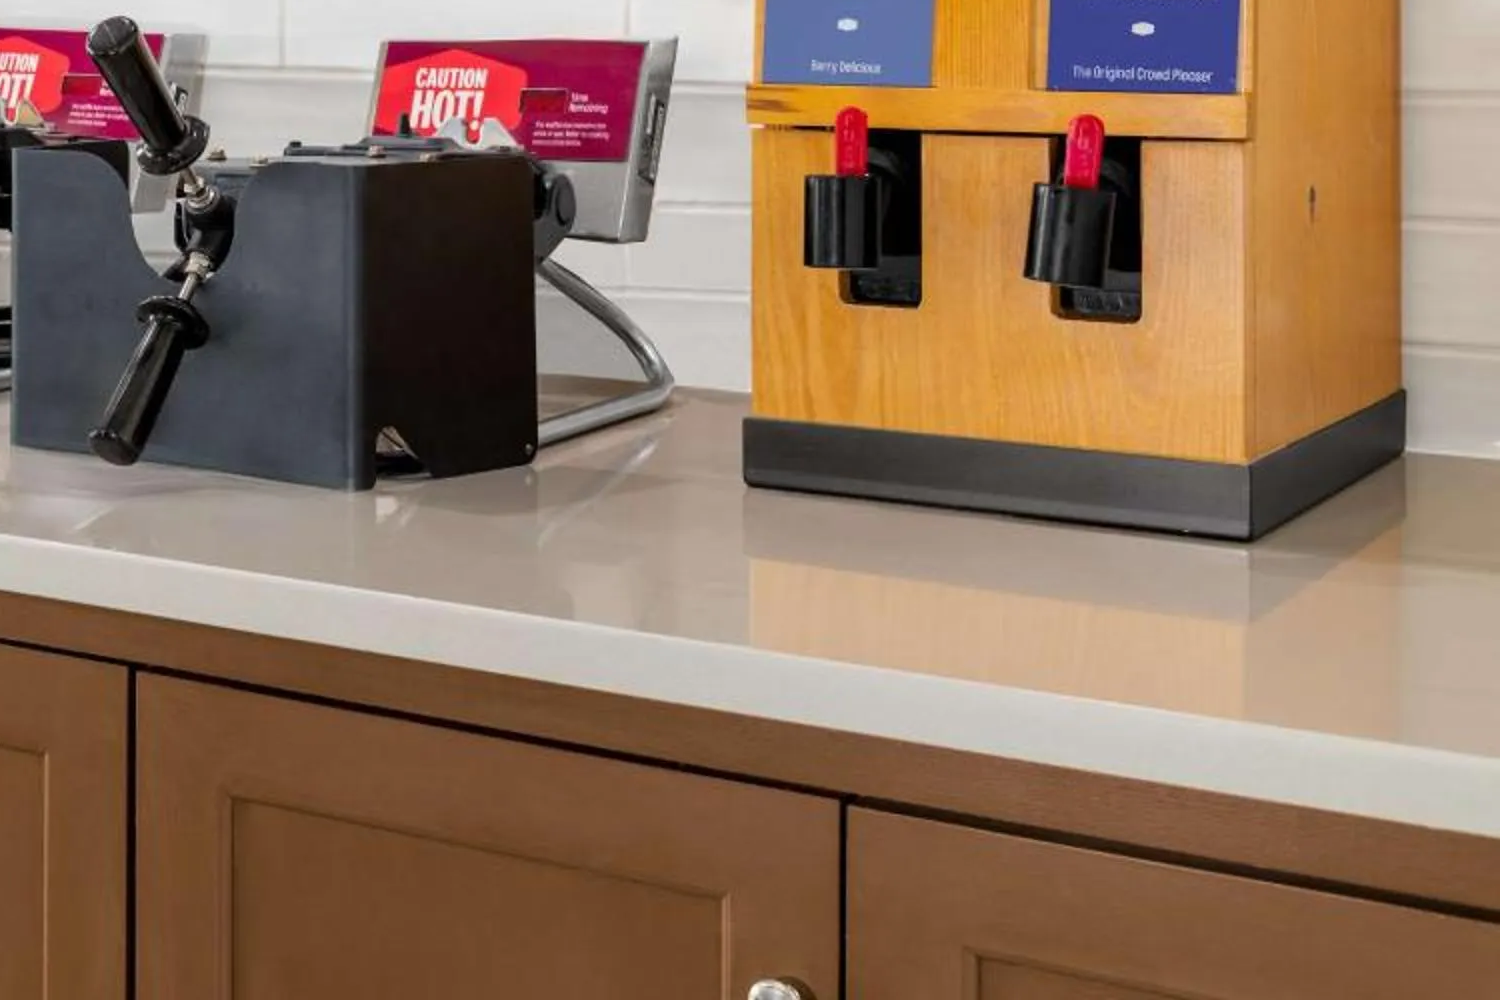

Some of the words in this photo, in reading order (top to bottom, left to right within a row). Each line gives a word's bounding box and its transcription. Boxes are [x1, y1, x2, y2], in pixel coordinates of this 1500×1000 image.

[415, 67, 489, 89] CAUTION
[1073, 65, 1092, 79] The
[1093, 65, 1135, 82] Original
[1136, 66, 1171, 82] Crowd
[1171, 68, 1214, 84] Pleaser
[409, 89, 485, 131] HOT!
